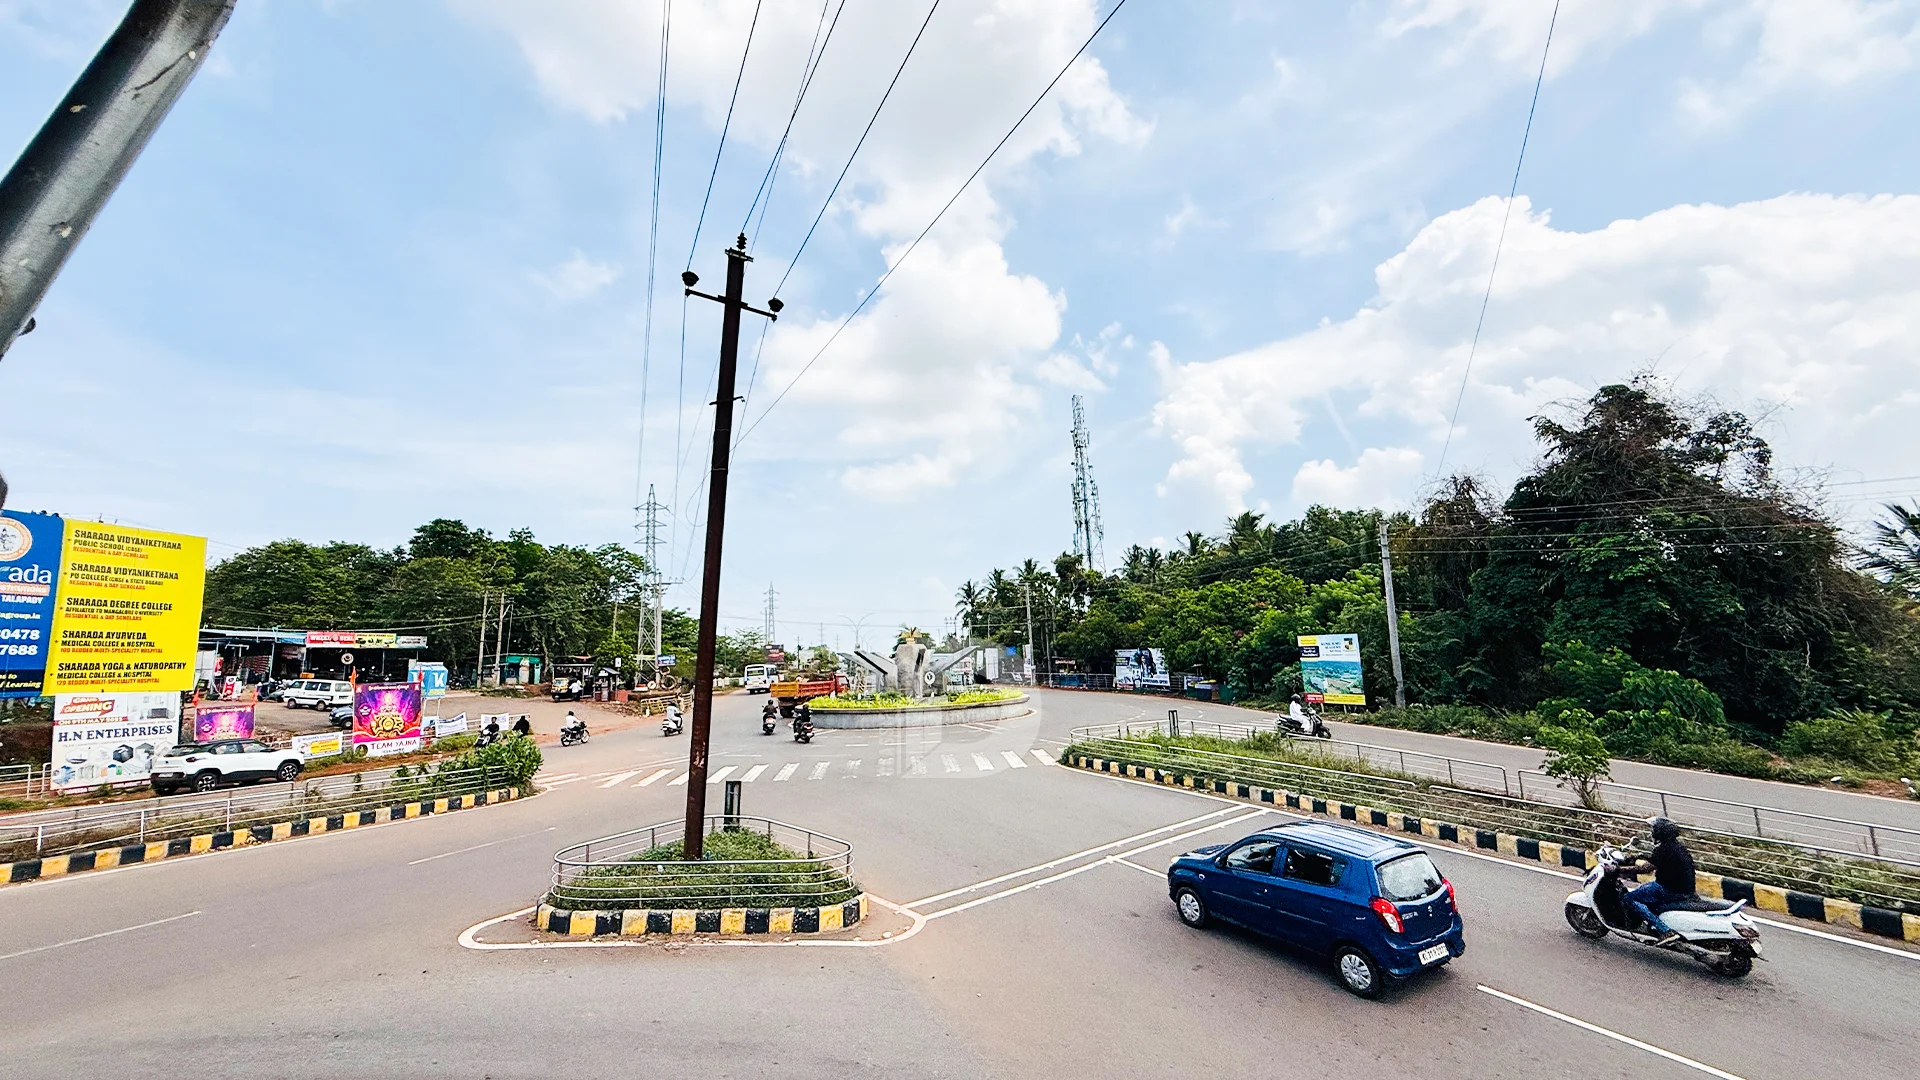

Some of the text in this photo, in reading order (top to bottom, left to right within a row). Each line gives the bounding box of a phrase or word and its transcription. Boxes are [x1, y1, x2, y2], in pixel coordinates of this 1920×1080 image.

[73, 539, 98, 547] PUBLIC
[99, 542, 125, 551] SCHOOL
[74, 529, 182, 550] SHARADA VIDYANIKETHANA
[0, 564, 52, 584] ada
[71, 562, 179, 580] SHARADA VIDYANIKETHANA
[80, 573, 109, 582] COLLEGE
[1, 595, 44, 604] TALAPADY
[66, 597, 173, 611] SHARADA DEGREE COLLEGE
[0, 628, 40, 640] 0478
[62, 630, 147, 640] SHARADA AYURVEDA
[58, 662, 100, 671] SHARADA
[102, 662, 124, 670] YOGA
[133, 662, 187, 670] NATUROPATHY
[6, 681, 41, 689] Learning
[64, 701, 113, 713] OPENING
[58, 725, 173, 742] H.N ENTERPRISES
